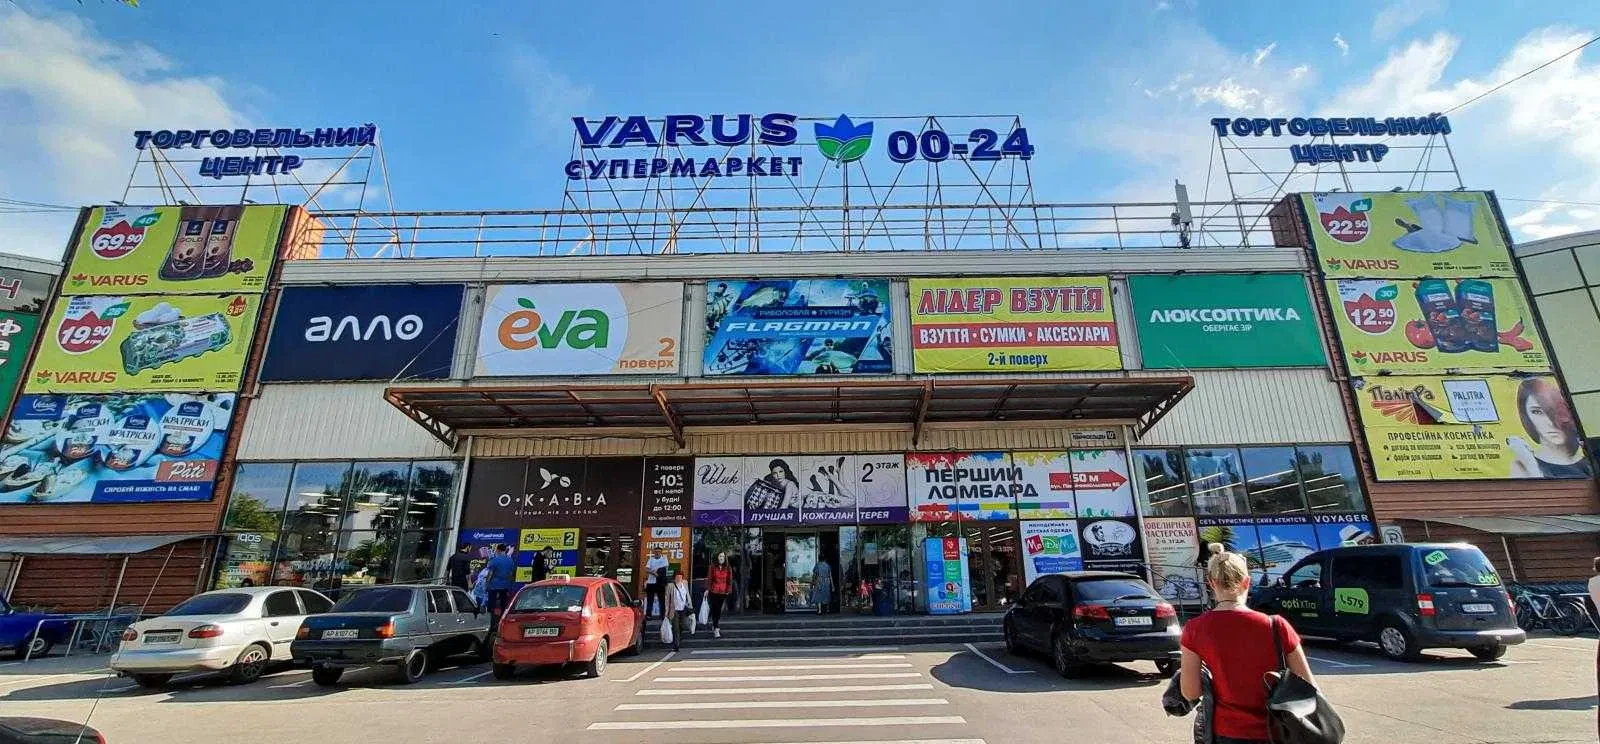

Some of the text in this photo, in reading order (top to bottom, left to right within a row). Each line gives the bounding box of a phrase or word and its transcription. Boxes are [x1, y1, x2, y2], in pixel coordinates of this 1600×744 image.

[572, 113, 799, 148] VARUS
[1211, 112, 1452, 137] ТОРГОВЕЛЬНИЙ
[134, 123, 378, 150] ТОРГОВЕЛЬНИЙ
[887, 127, 1035, 164] 00-24
[1290, 143, 1390, 166] ЦЕНТР
[200, 155, 302, 179] ЦЕНТР
[564, 156, 803, 180] СУПЕРМАРКЕТ
[1342, 259, 1399, 271] VARUS
[90, 274, 149, 287] VARUS
[917, 287, 1104, 315] ЛІДЕР ВЗУТТЯ
[1150, 308, 1301, 324] ЛЮКСОПТИКА
[725, 321, 872, 333] FLAGMAN
[920, 326, 1110, 344] ВЗУТТЯ СУМКИ АКСЕСУАРИ
[658, 337, 675, 357] 2
[619, 358, 675, 370] поверх
[988, 353, 1049, 369] 2-й поверх
[1369, 351, 1429, 364] VARUS
[54, 371, 117, 384] VARUS
[1387, 430, 1442, 441] ПРОФЕСІЙНА
[861, 463, 874, 483] 2
[925, 466, 1024, 483] ПЕРШИЙ
[927, 483, 1039, 500] ЛОМБАРД
[751, 512, 794, 521] ЛУЧШАЯ
[1313, 513, 1370, 524] VOYAGER
[646, 541, 684, 550] ІНТЕРНЕТ
